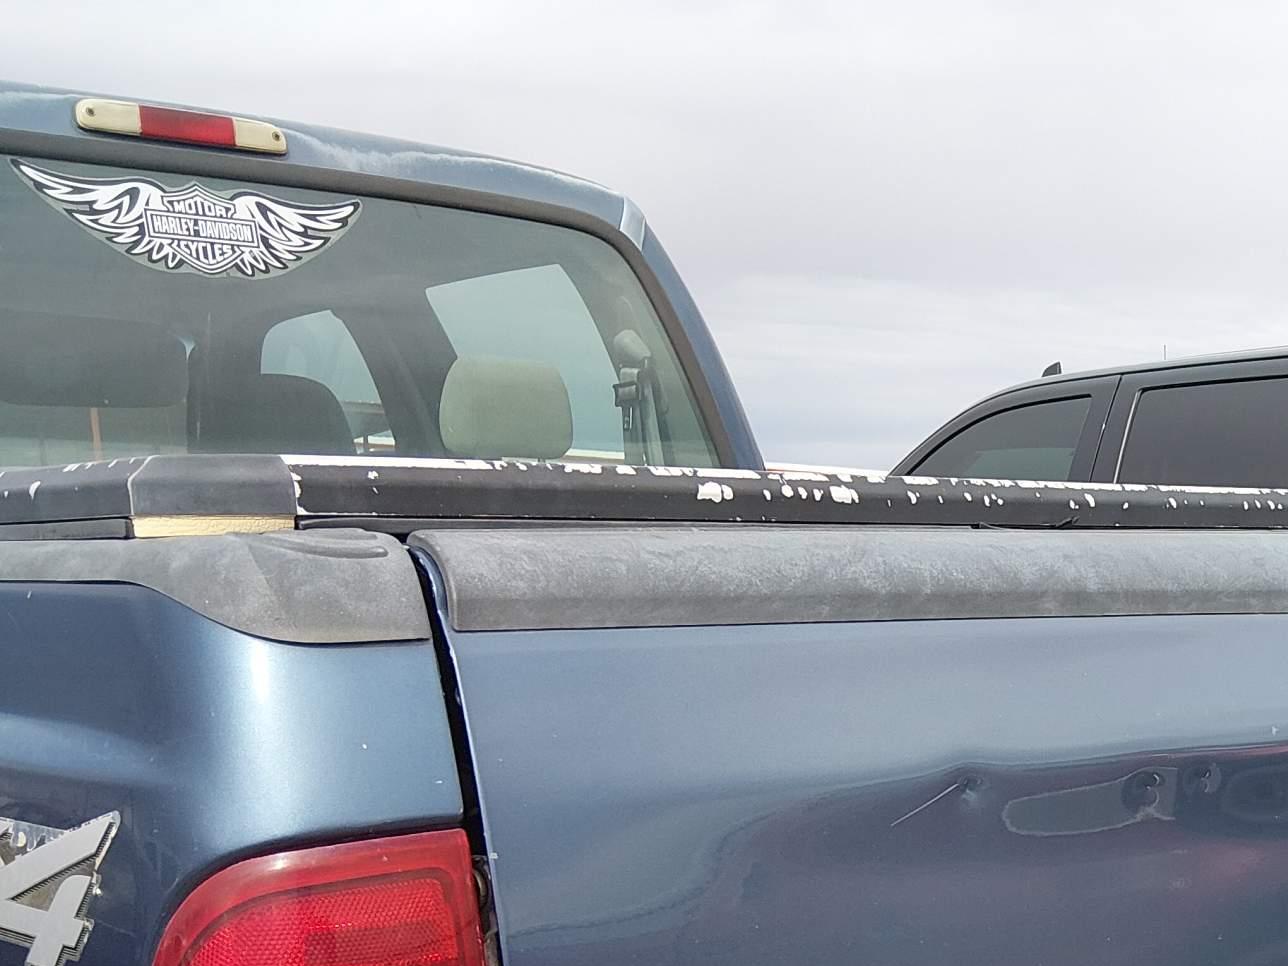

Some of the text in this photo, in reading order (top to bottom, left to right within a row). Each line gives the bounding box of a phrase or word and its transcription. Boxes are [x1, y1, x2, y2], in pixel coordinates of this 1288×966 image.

[174, 199, 227, 218] MOTOR
[152, 214, 251, 241] HARLEY-DAVIDSON
[180, 240, 233, 264] CYCLES
